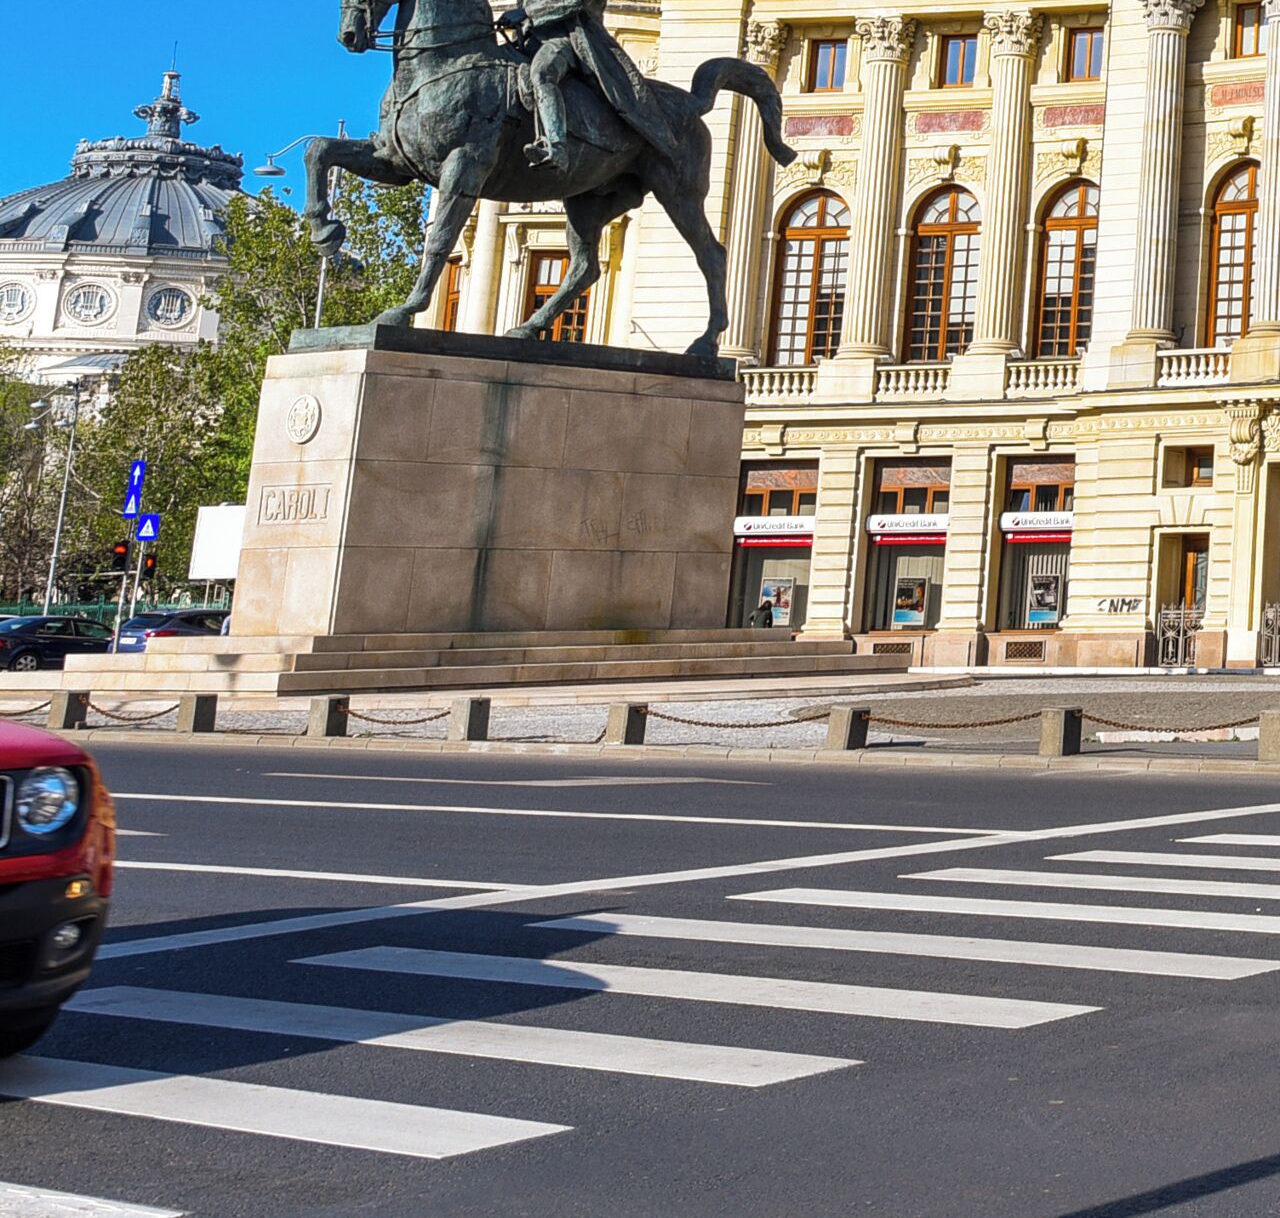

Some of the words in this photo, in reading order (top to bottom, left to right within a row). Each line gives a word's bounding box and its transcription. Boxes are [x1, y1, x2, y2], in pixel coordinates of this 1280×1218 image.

[265, 489, 317, 521] CAROL
[753, 521, 786, 530] UniCredit
[786, 522, 805, 530] Bank
[887, 519, 919, 528] UniCredit
[920, 519, 938, 527] Bank
[1020, 517, 1052, 526] UniCredit
[1053, 517, 1071, 525] Bank
